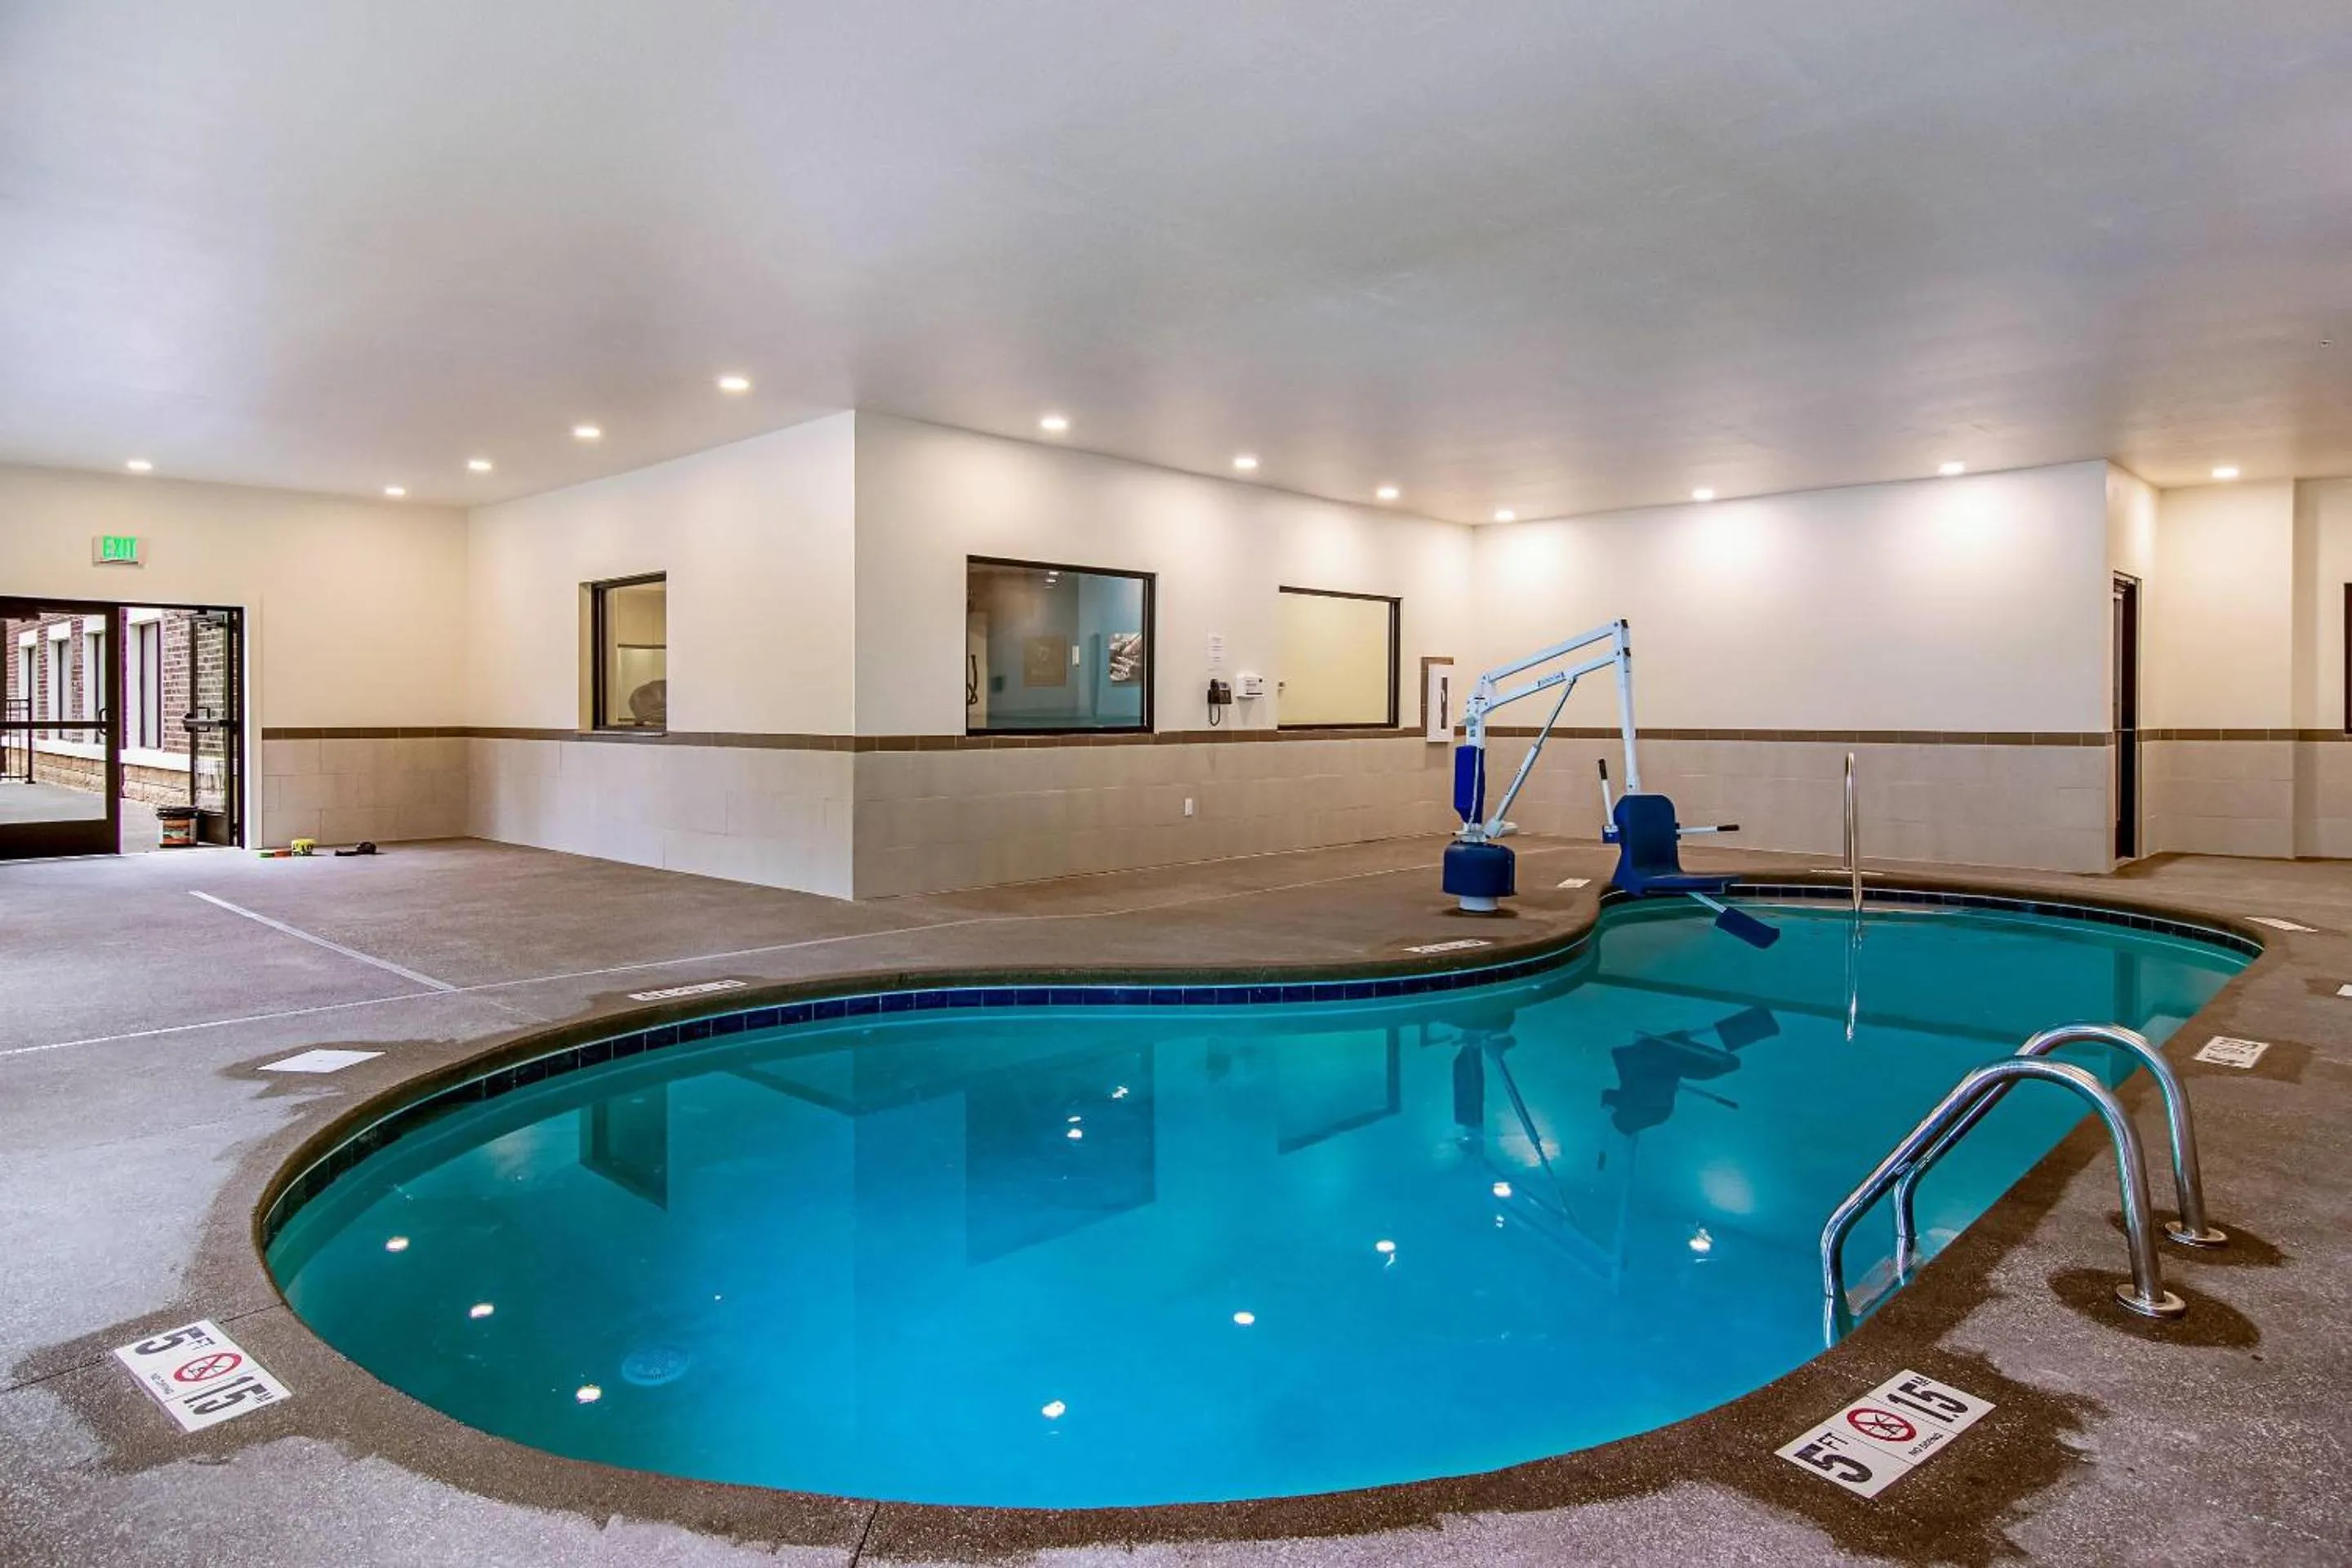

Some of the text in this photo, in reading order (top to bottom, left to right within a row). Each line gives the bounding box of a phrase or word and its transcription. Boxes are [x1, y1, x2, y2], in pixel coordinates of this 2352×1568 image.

[102, 535, 136, 559] EXIT
[135, 1325, 216, 1356] 5 FT
[183, 1375, 268, 1414] 1.5
[1886, 1382, 1969, 1423] 1.5
[1793, 1432, 1873, 1483] 5 FT
